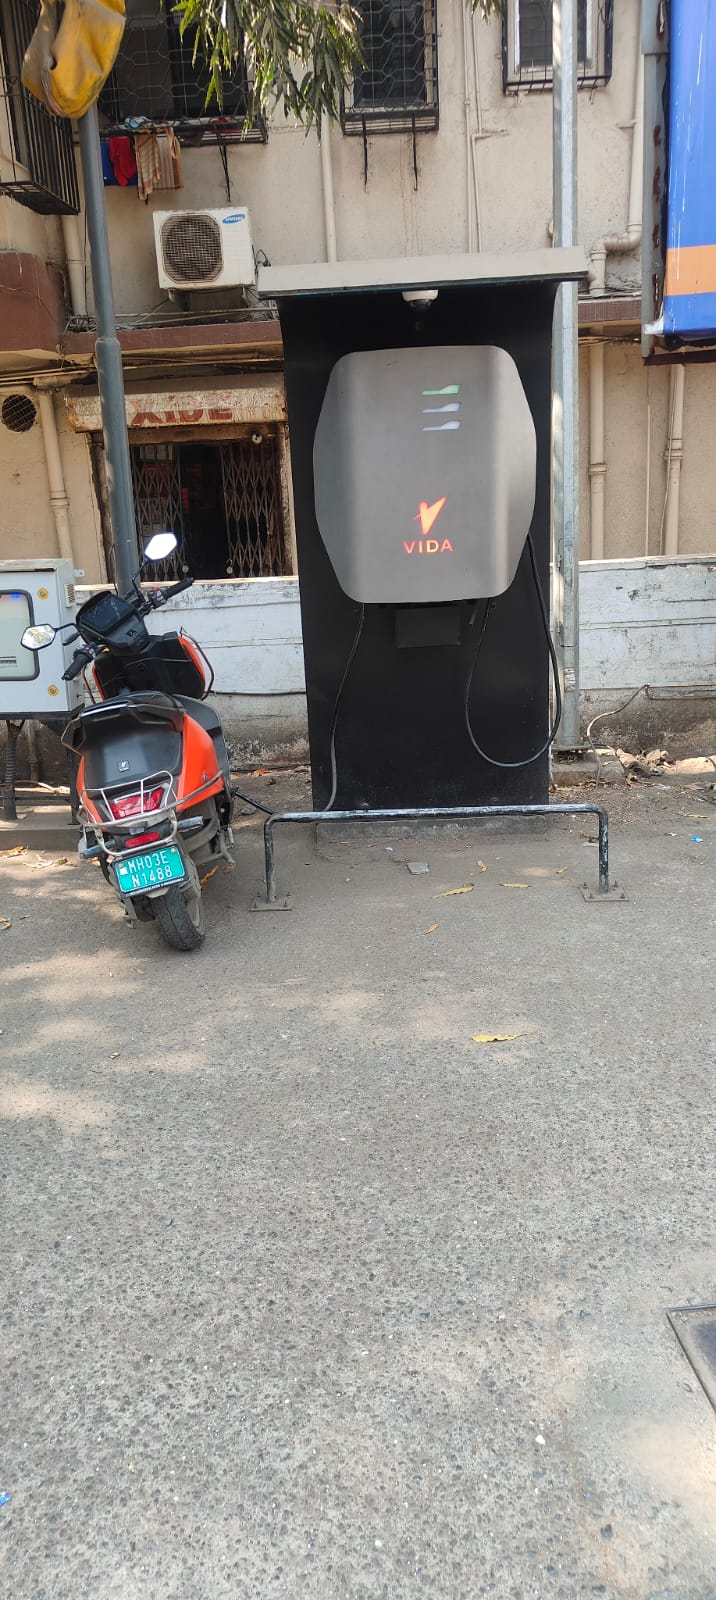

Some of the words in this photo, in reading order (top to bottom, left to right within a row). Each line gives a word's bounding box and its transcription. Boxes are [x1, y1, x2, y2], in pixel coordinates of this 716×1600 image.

[402, 538, 454, 554] VIDA
[127, 850, 169, 874] MH03E
[131, 866, 173, 888] N1488
